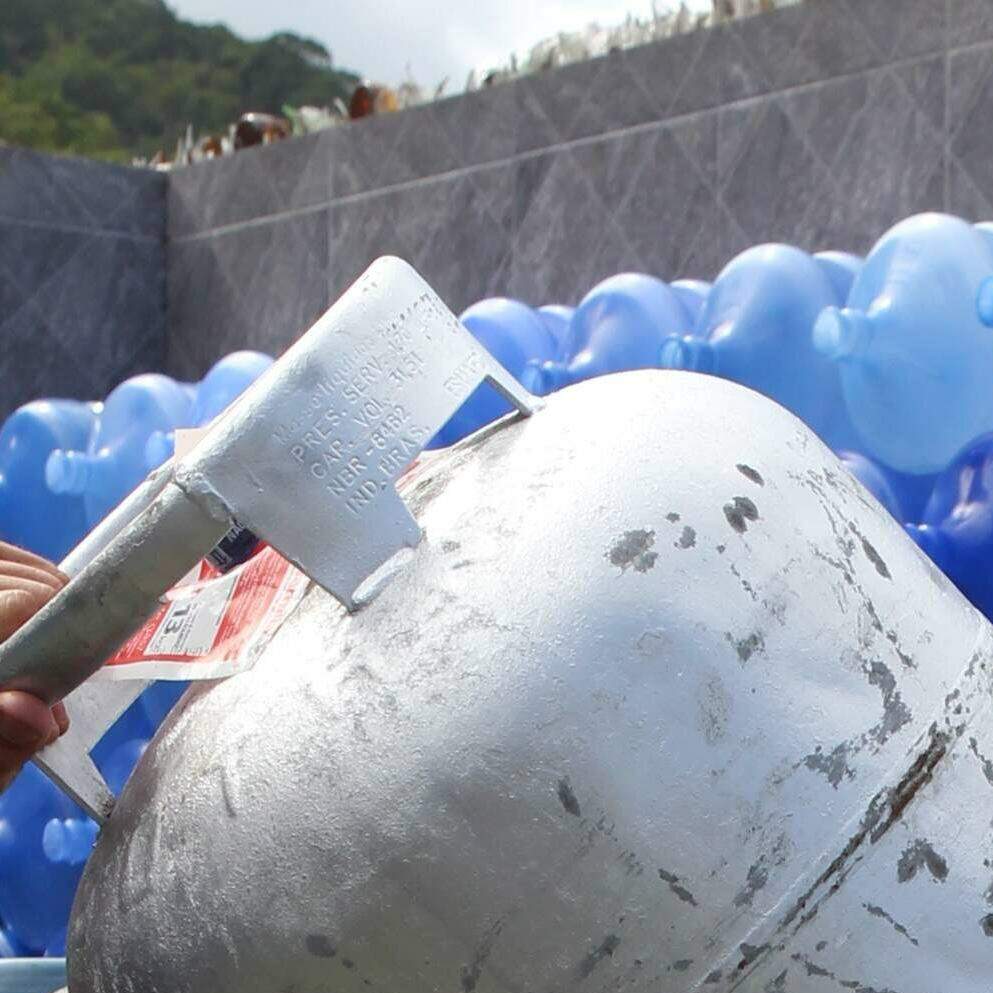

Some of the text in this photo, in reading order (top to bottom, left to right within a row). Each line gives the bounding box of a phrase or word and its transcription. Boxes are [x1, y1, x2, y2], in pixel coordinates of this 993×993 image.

[288, 401, 349, 465] PRES.
[339, 351, 391, 406] SERV.
[325, 454, 369, 500] NBR
[343, 471, 388, 518] IND.
